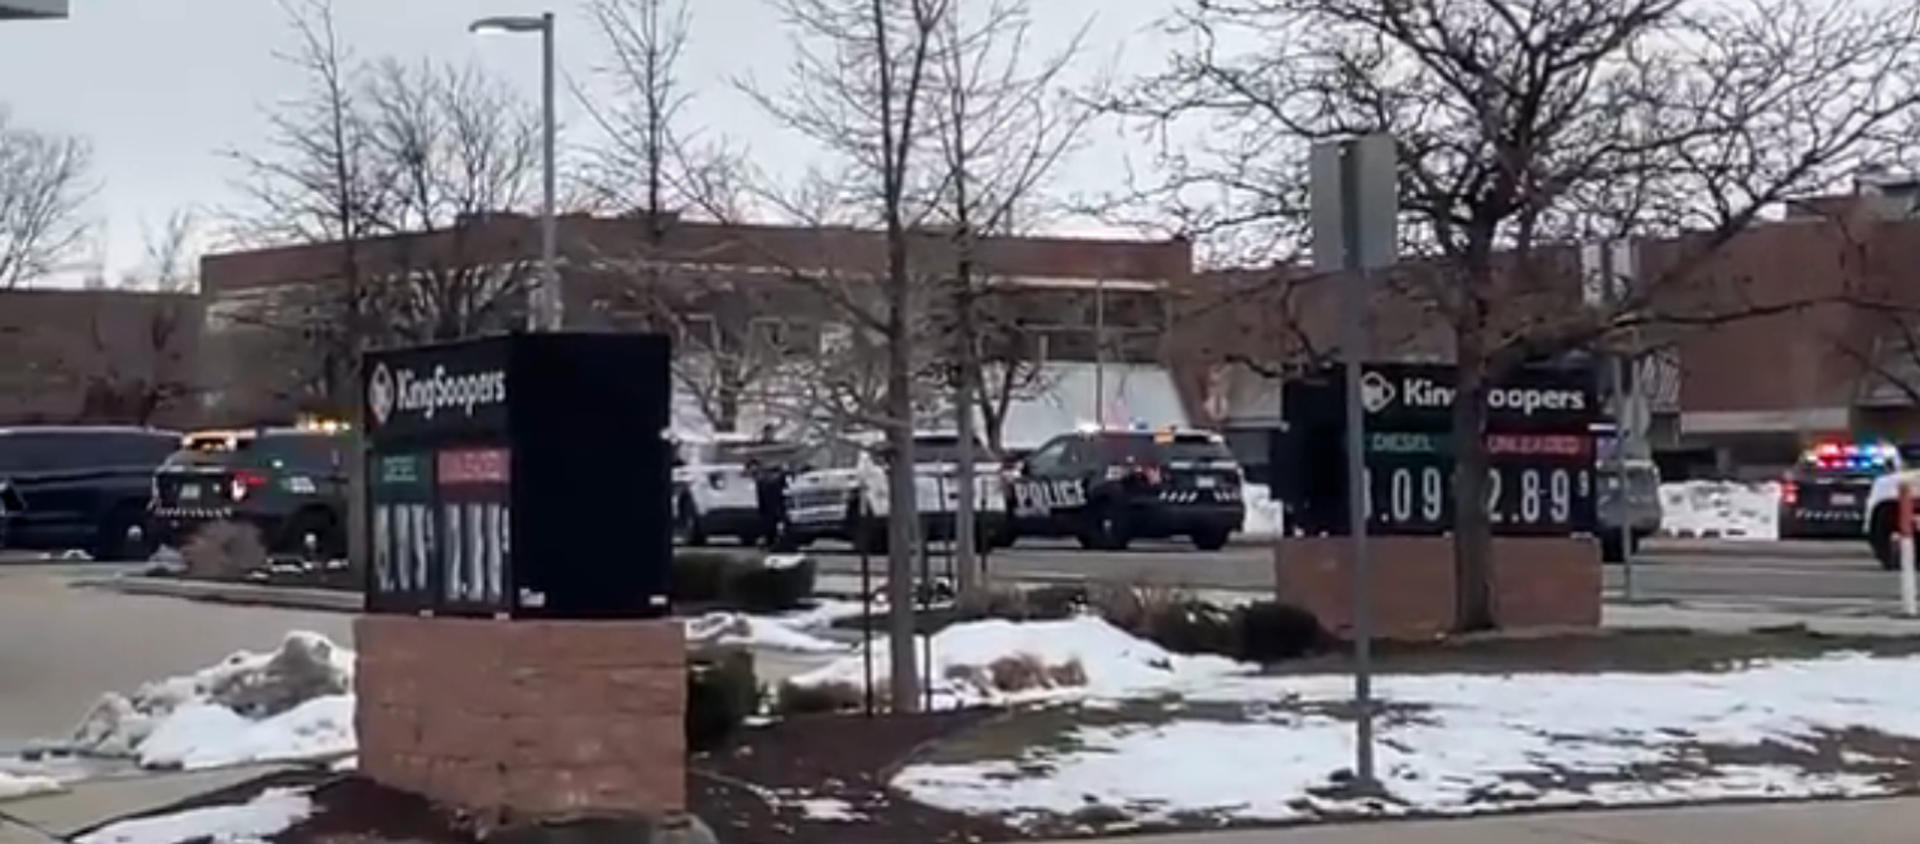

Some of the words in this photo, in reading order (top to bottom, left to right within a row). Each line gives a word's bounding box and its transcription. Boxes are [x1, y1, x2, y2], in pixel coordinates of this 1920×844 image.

[1403, 377, 1586, 414] Kinoopers
[1487, 435, 1581, 454] UNLEADED
[1014, 478, 1087, 512] POLICE
